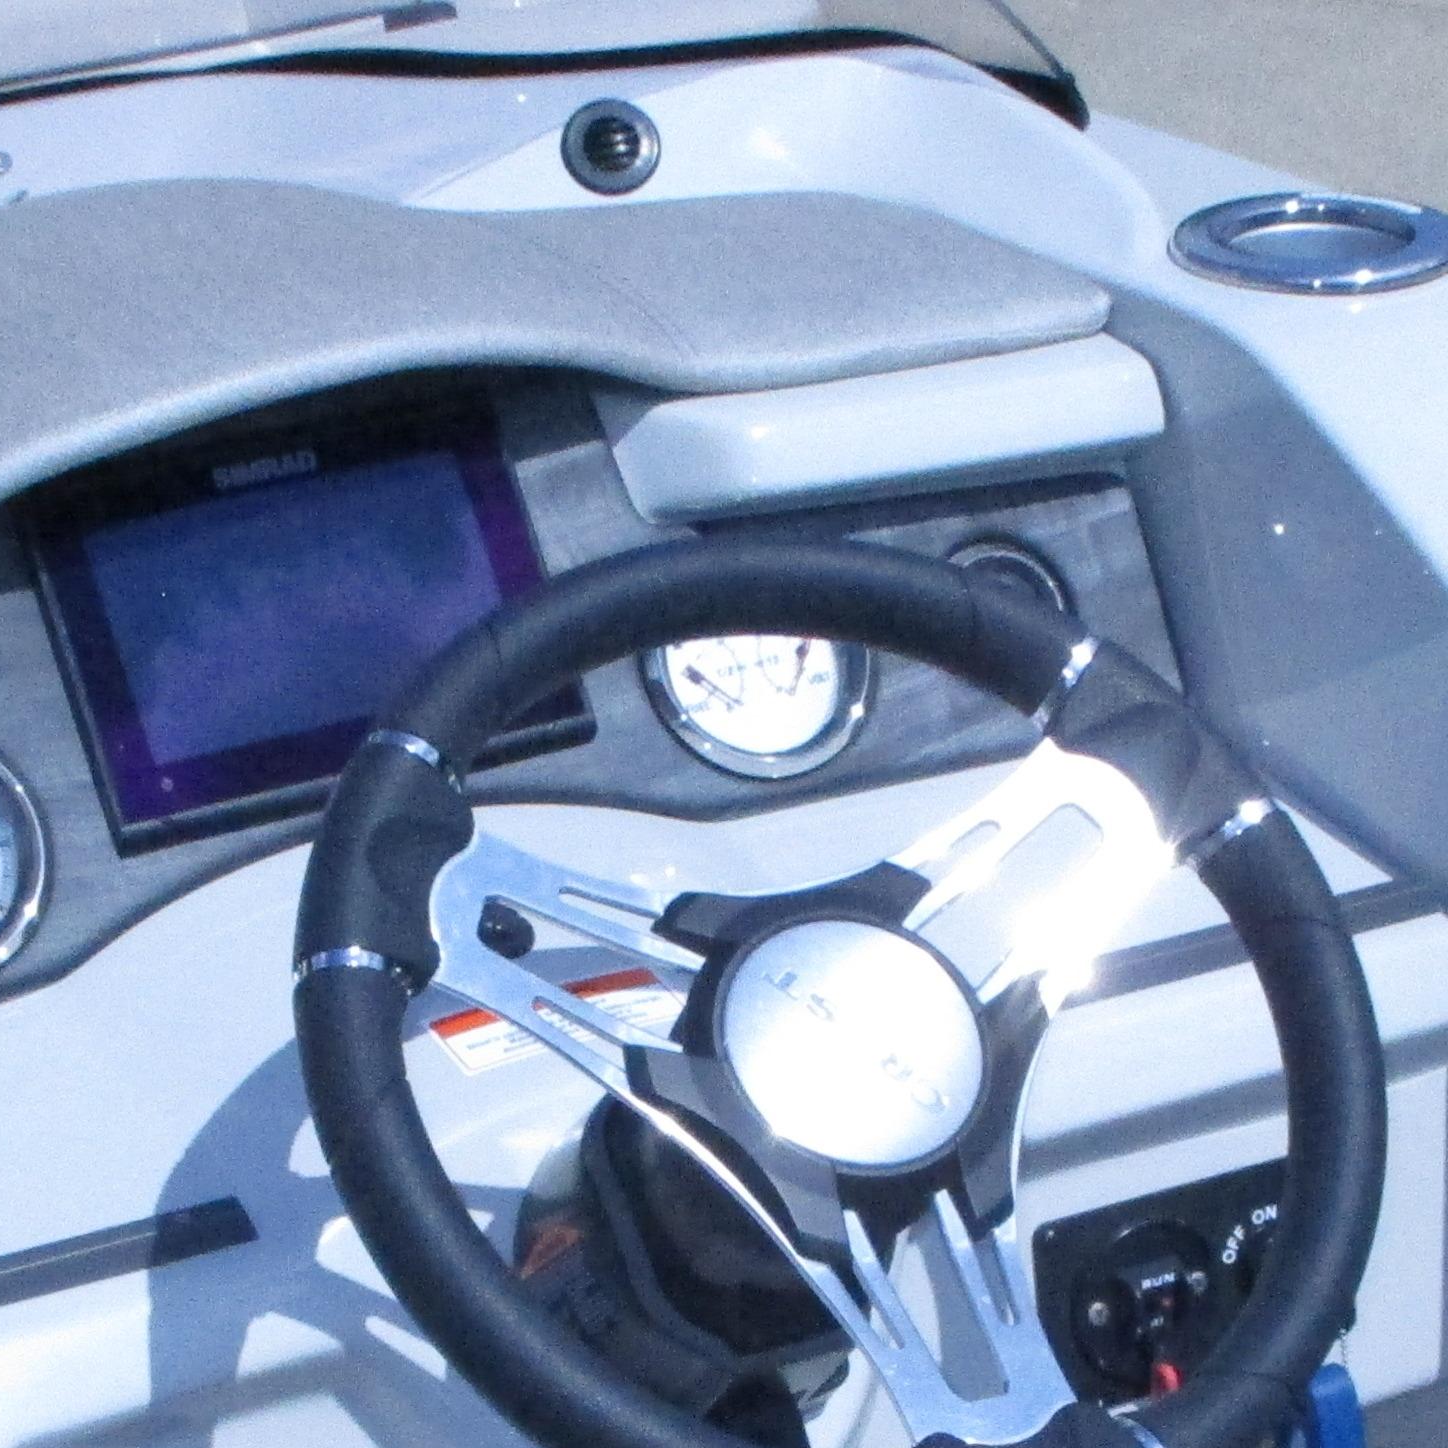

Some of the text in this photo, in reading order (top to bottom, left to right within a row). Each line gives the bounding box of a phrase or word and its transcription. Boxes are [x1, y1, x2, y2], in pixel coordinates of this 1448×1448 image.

[1251, 1204, 1278, 1225] ON
[1221, 1224, 1245, 1264] OFF
[1141, 1272, 1176, 1290] RUN
